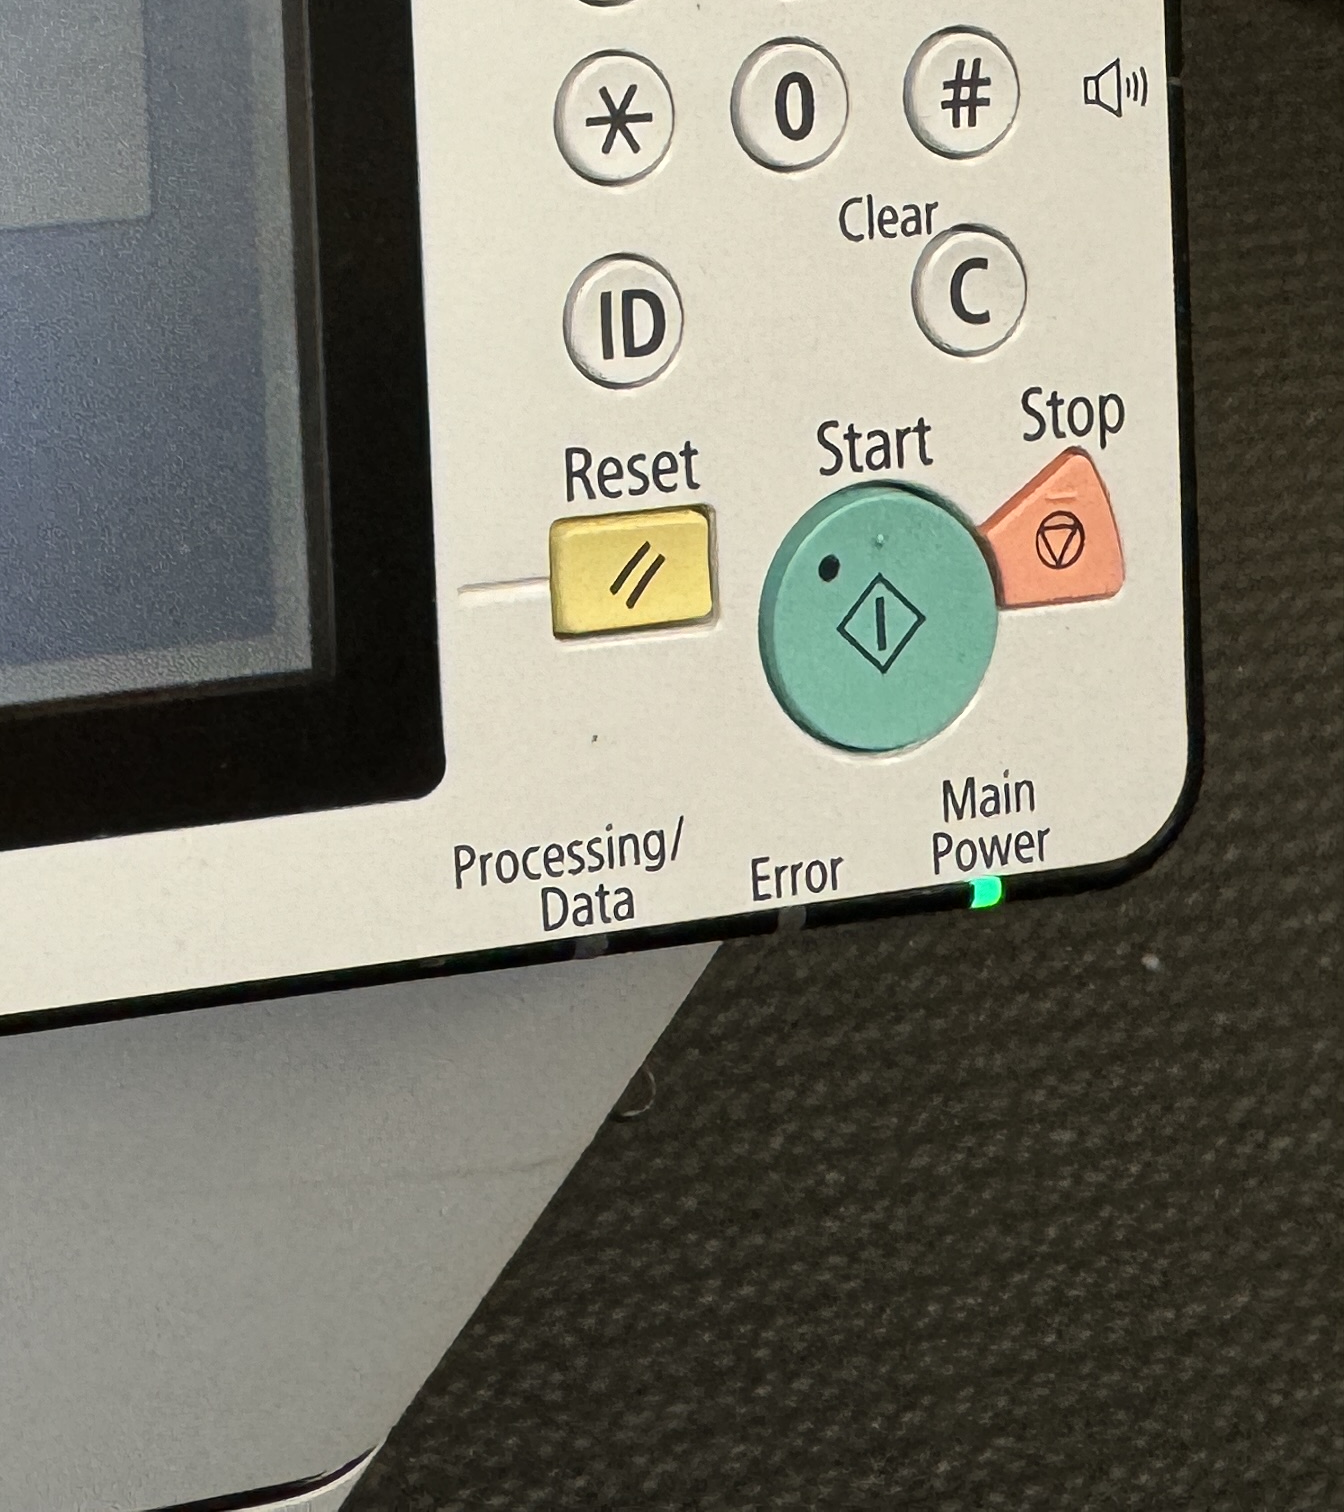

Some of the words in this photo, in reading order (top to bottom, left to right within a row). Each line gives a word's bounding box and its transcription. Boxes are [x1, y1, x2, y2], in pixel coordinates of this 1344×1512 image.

[775, 72, 814, 141] 0
[941, 58, 991, 128] #
[839, 192, 939, 242] Clear
[950, 258, 990, 324] C
[601, 287, 666, 361] ID
[817, 417, 933, 476] Start
[1021, 387, 1126, 449] Stop
[565, 441, 701, 502] Reset
[943, 770, 1034, 822] Main
[454, 816, 686, 890] Processing/
[752, 854, 844, 903] Error
[933, 823, 1051, 876] Power
[541, 883, 636, 931] Data
